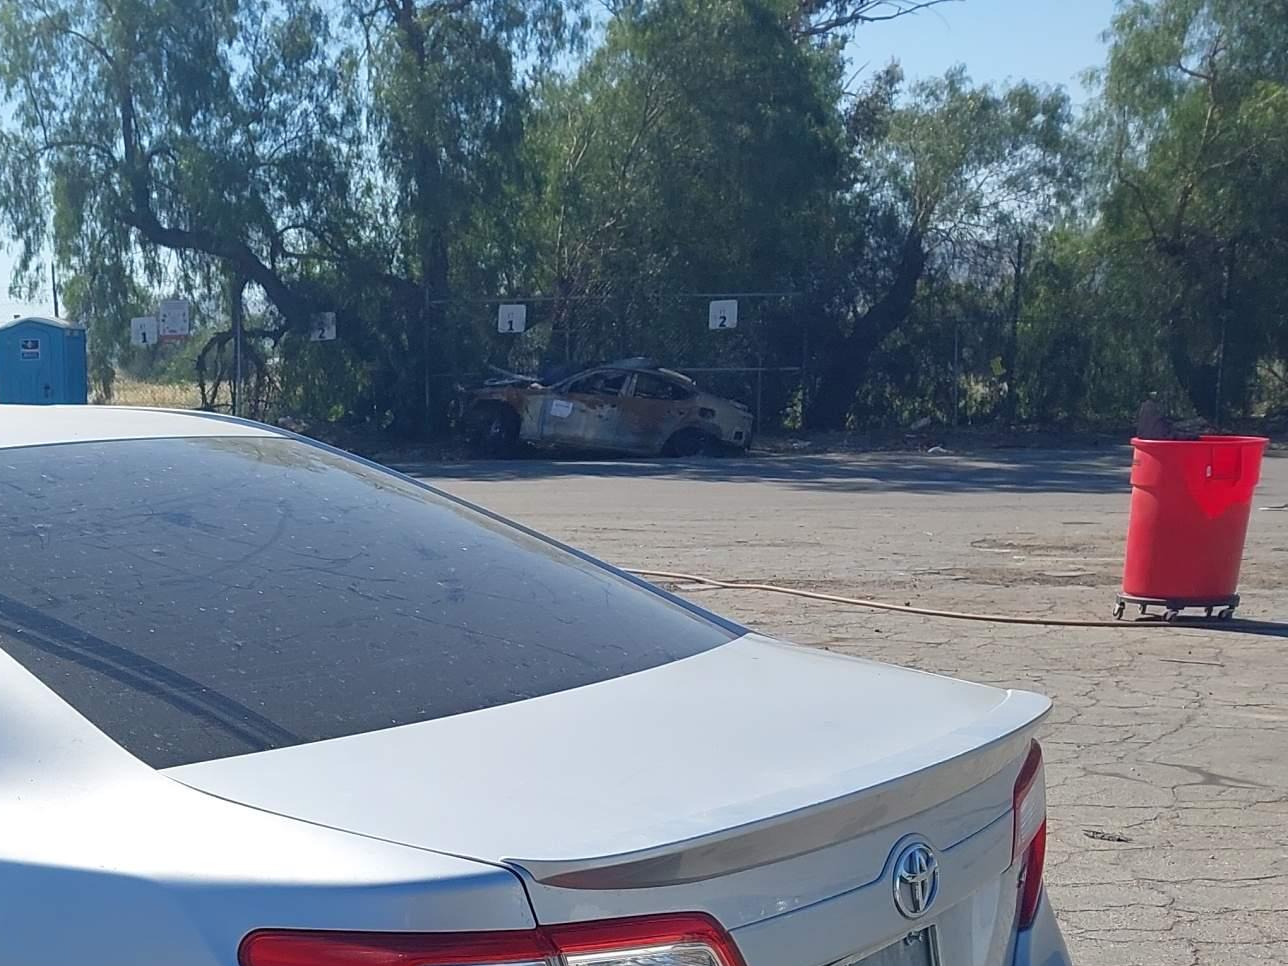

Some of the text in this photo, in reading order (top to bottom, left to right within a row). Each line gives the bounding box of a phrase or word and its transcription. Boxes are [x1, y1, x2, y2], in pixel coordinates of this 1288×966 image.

[508, 320, 514, 331] 1
[718, 316, 727, 328] 2
[141, 332, 148, 343] 1
[318, 327, 326, 339] 2
